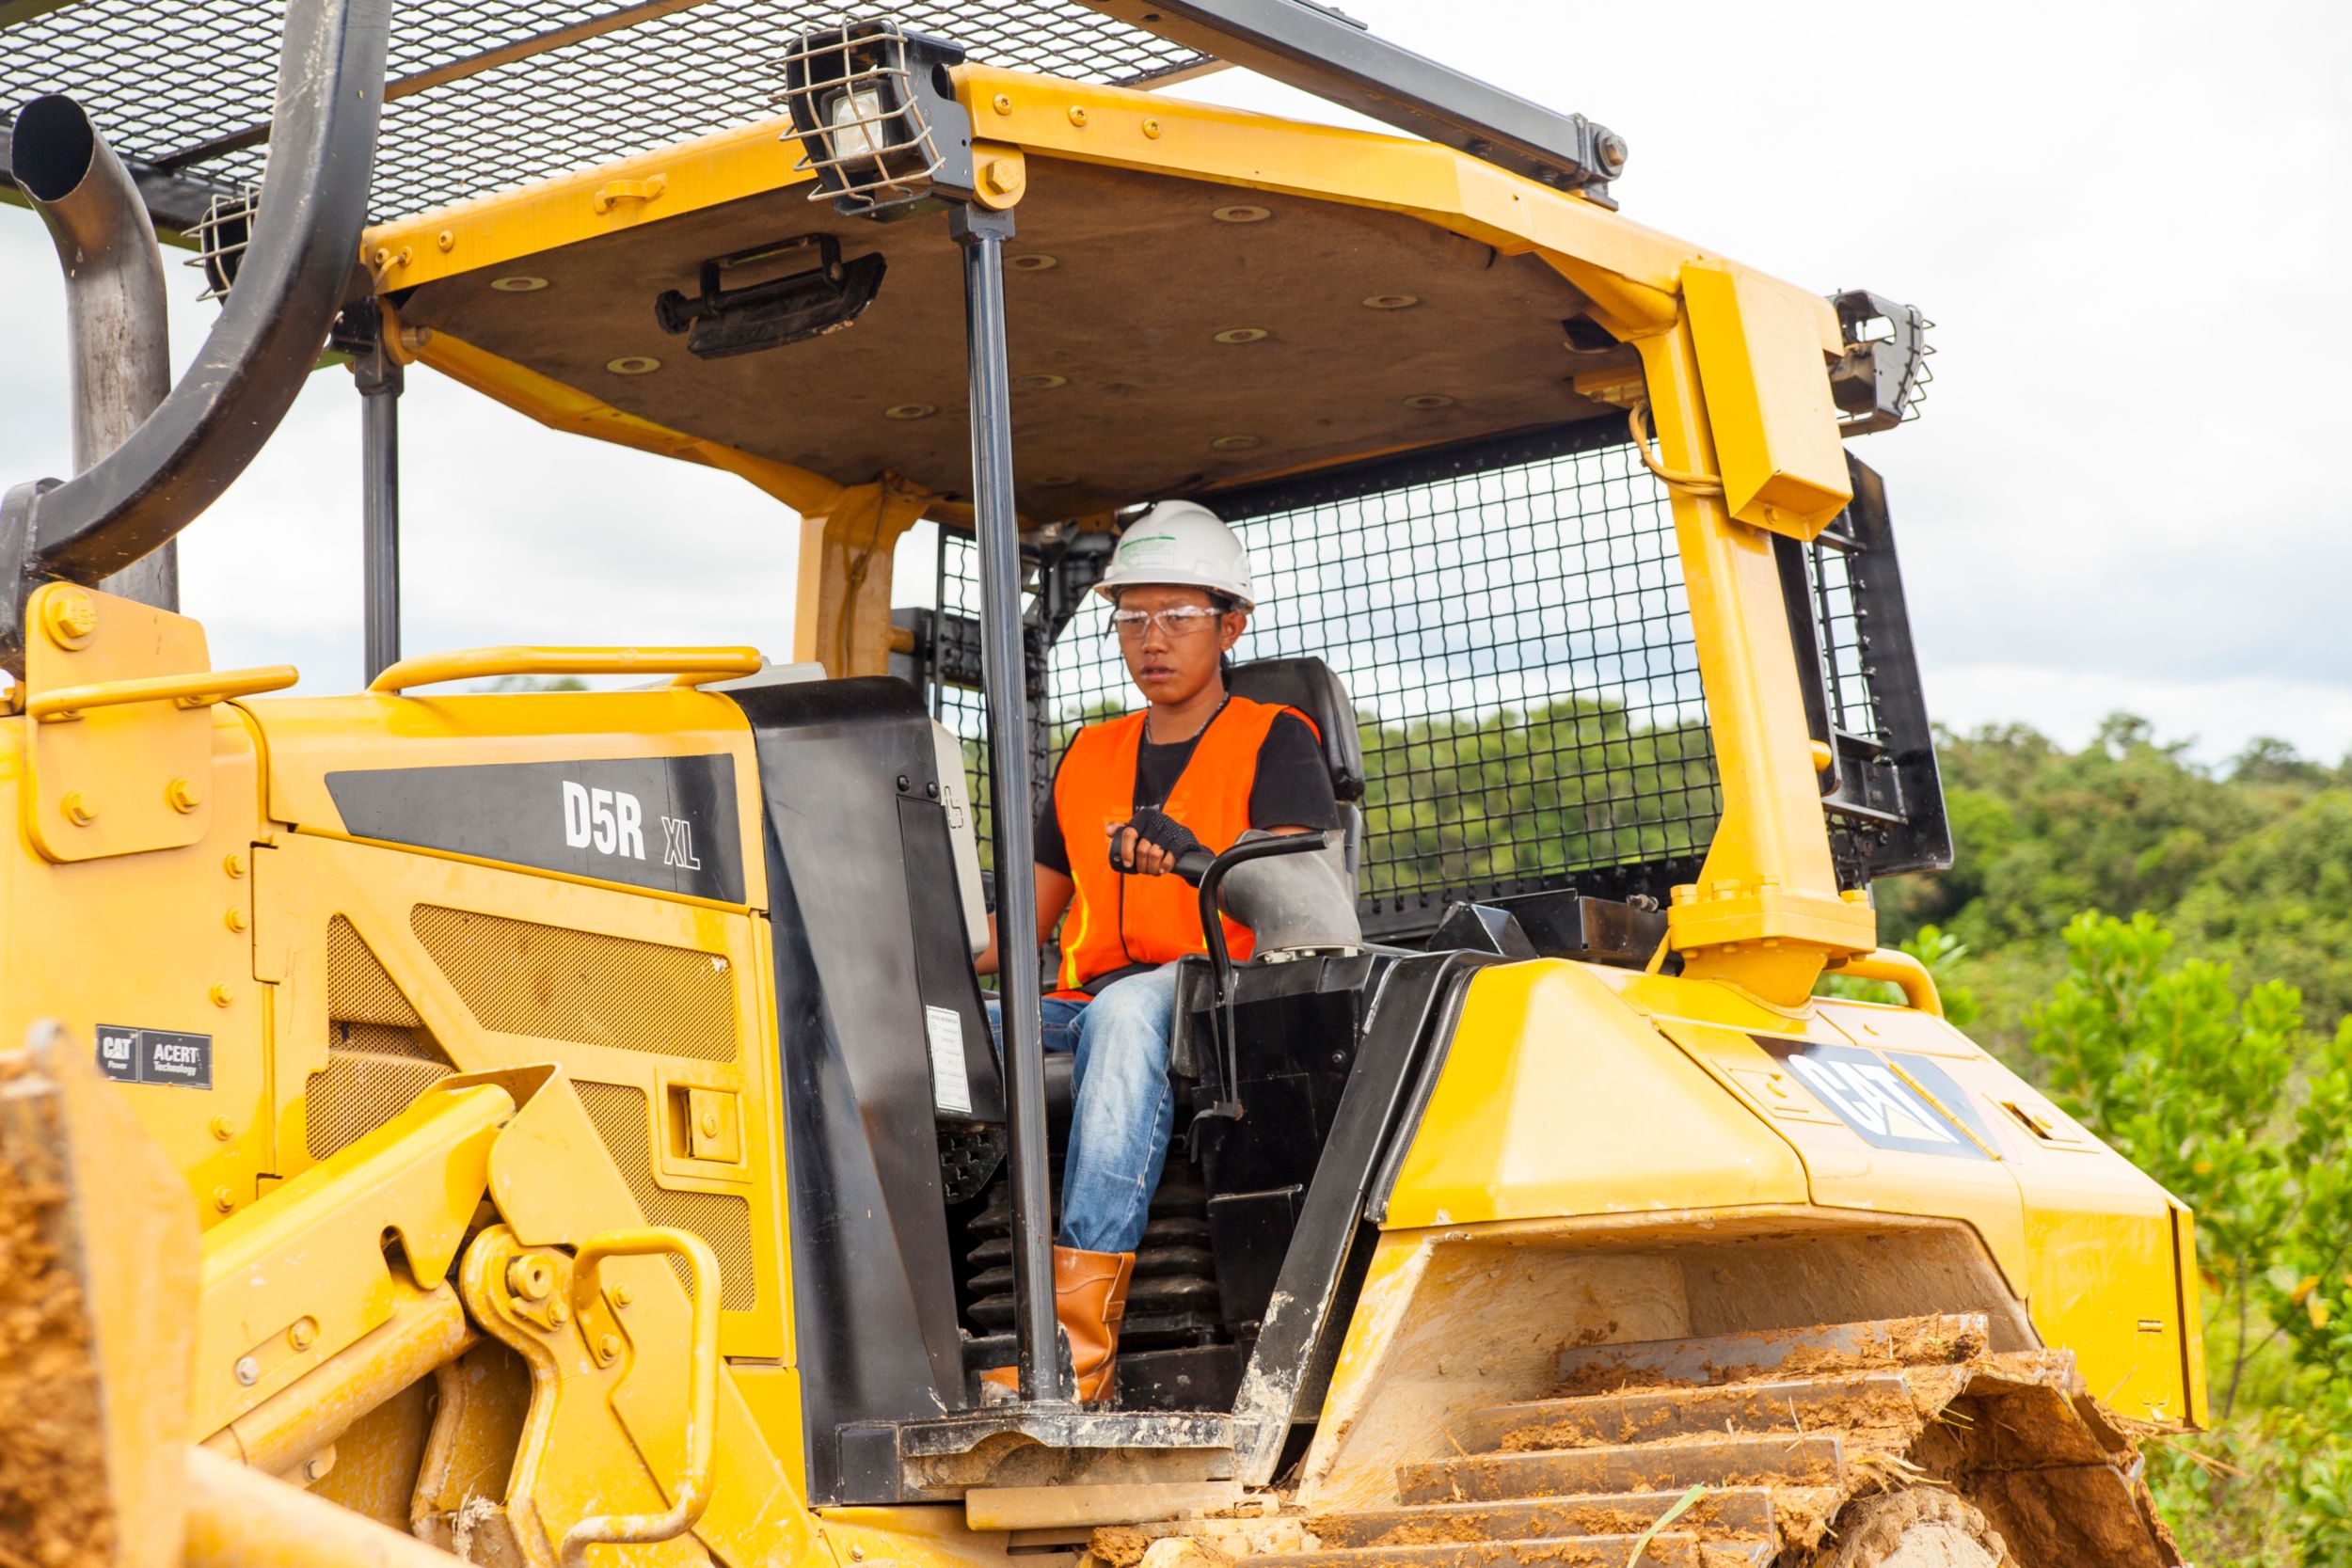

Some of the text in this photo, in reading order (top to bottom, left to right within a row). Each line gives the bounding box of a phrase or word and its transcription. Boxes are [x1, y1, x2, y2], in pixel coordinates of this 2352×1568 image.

[563, 780, 701, 870] D5R XL
[103, 1037, 132, 1060] CAT
[153, 1043, 199, 1064] ACERT
[153, 1061, 197, 1076] Technology
[1788, 1054, 1961, 1144] CAT
